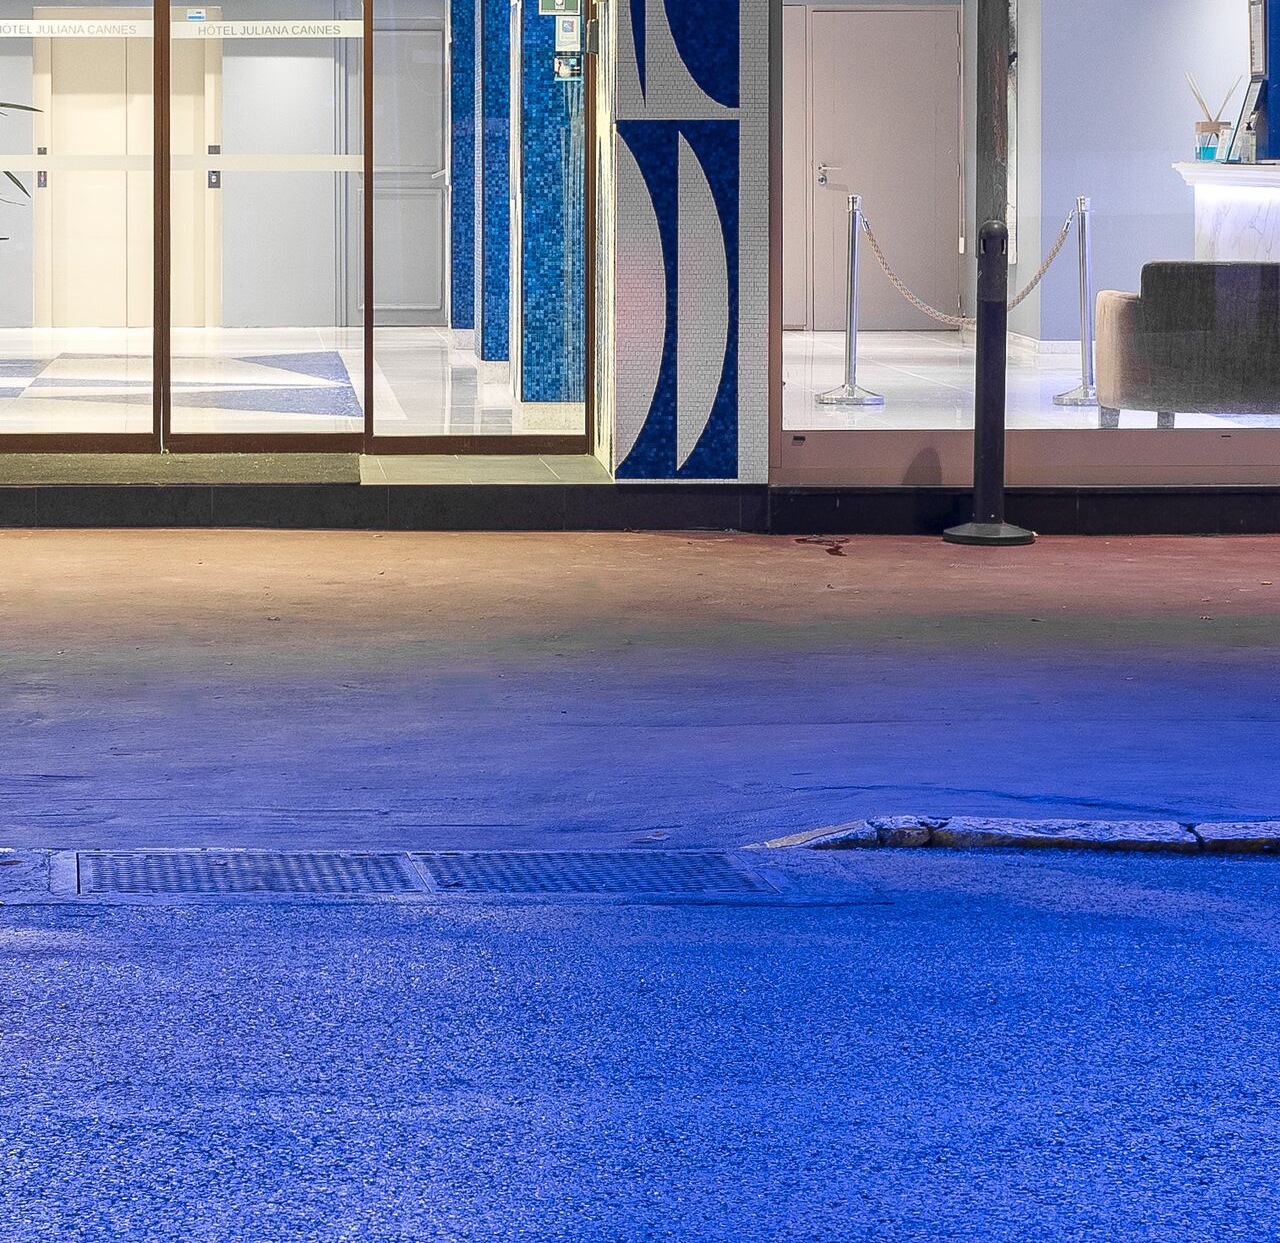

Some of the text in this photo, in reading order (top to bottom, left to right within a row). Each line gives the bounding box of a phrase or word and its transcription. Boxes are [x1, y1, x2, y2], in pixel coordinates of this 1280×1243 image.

[36, 24, 85, 35] JULIANA
[87, 24, 137, 35] CANNES
[198, 24, 341, 36] HÔTEL JULIANA CANNES
